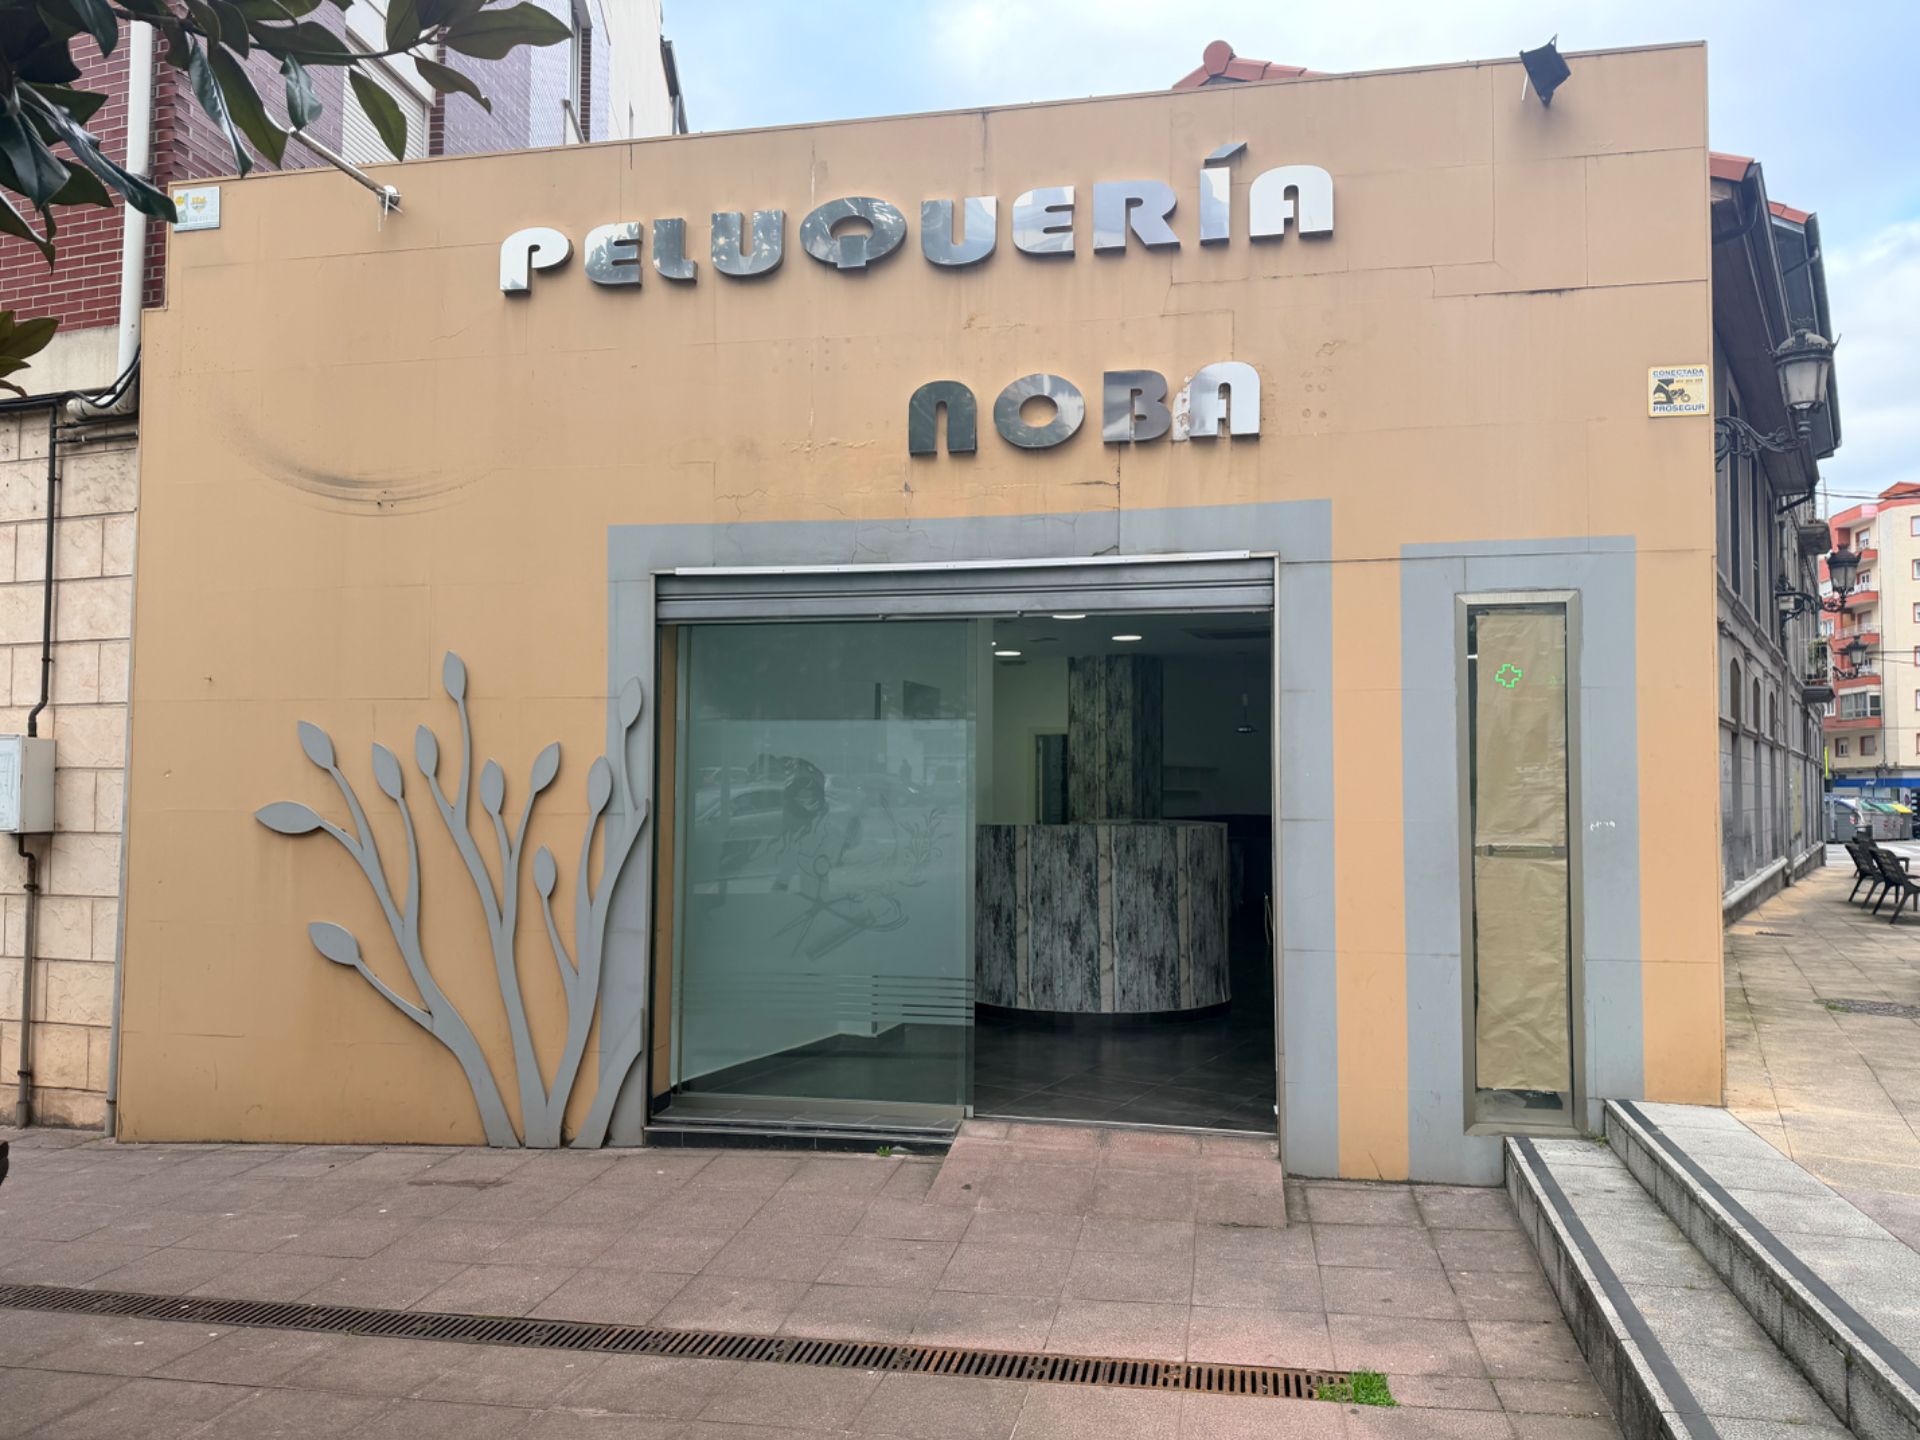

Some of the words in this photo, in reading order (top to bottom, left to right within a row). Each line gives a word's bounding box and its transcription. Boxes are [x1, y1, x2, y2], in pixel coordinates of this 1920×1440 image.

[499, 142, 1334, 296] PELUQUERÍA
[1652, 368, 1704, 377] CONECTADA
[908, 361, 1261, 455] NOBA
[1653, 403, 1705, 412] PROSEGUR
